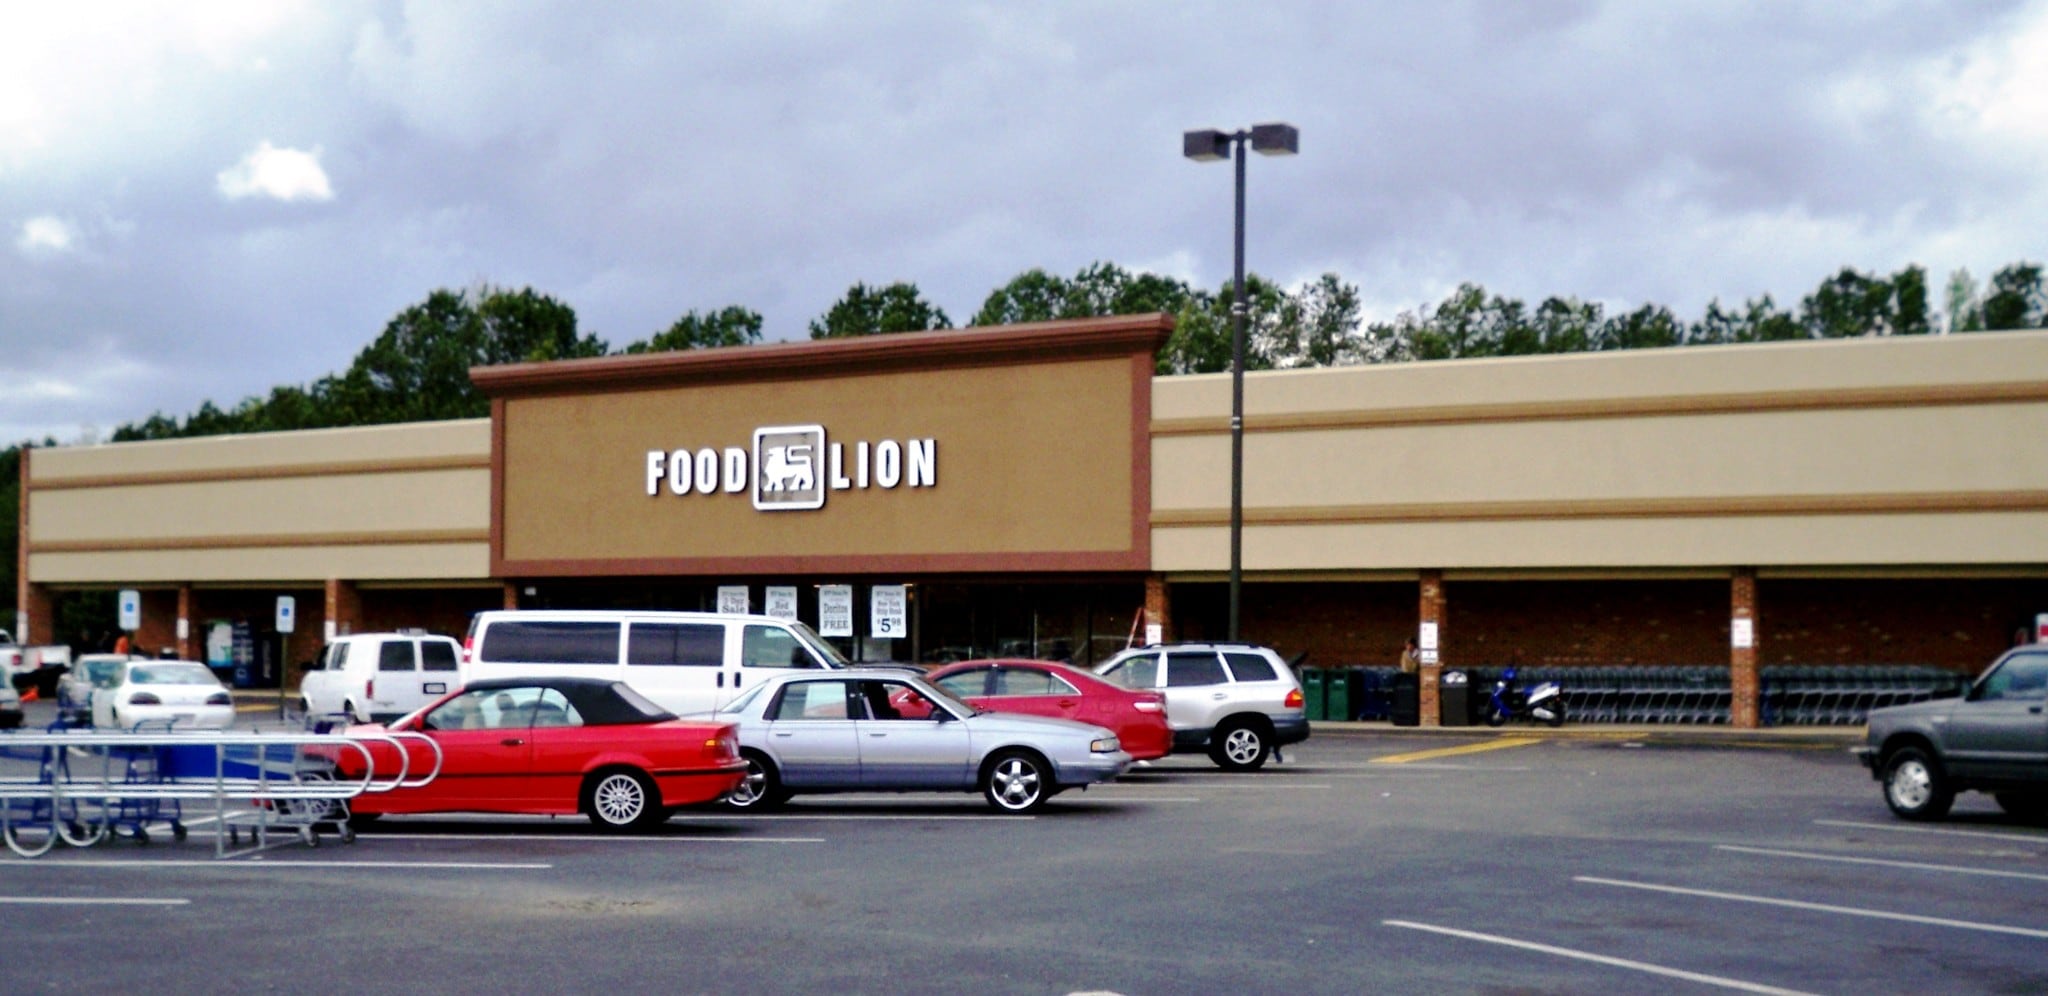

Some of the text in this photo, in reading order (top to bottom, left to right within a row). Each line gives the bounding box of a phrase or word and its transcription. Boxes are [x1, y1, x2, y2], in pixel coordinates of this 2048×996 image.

[647, 439, 935, 495] FOOD LION
[722, 605, 745, 613] Sale
[823, 620, 848, 629] FREE
